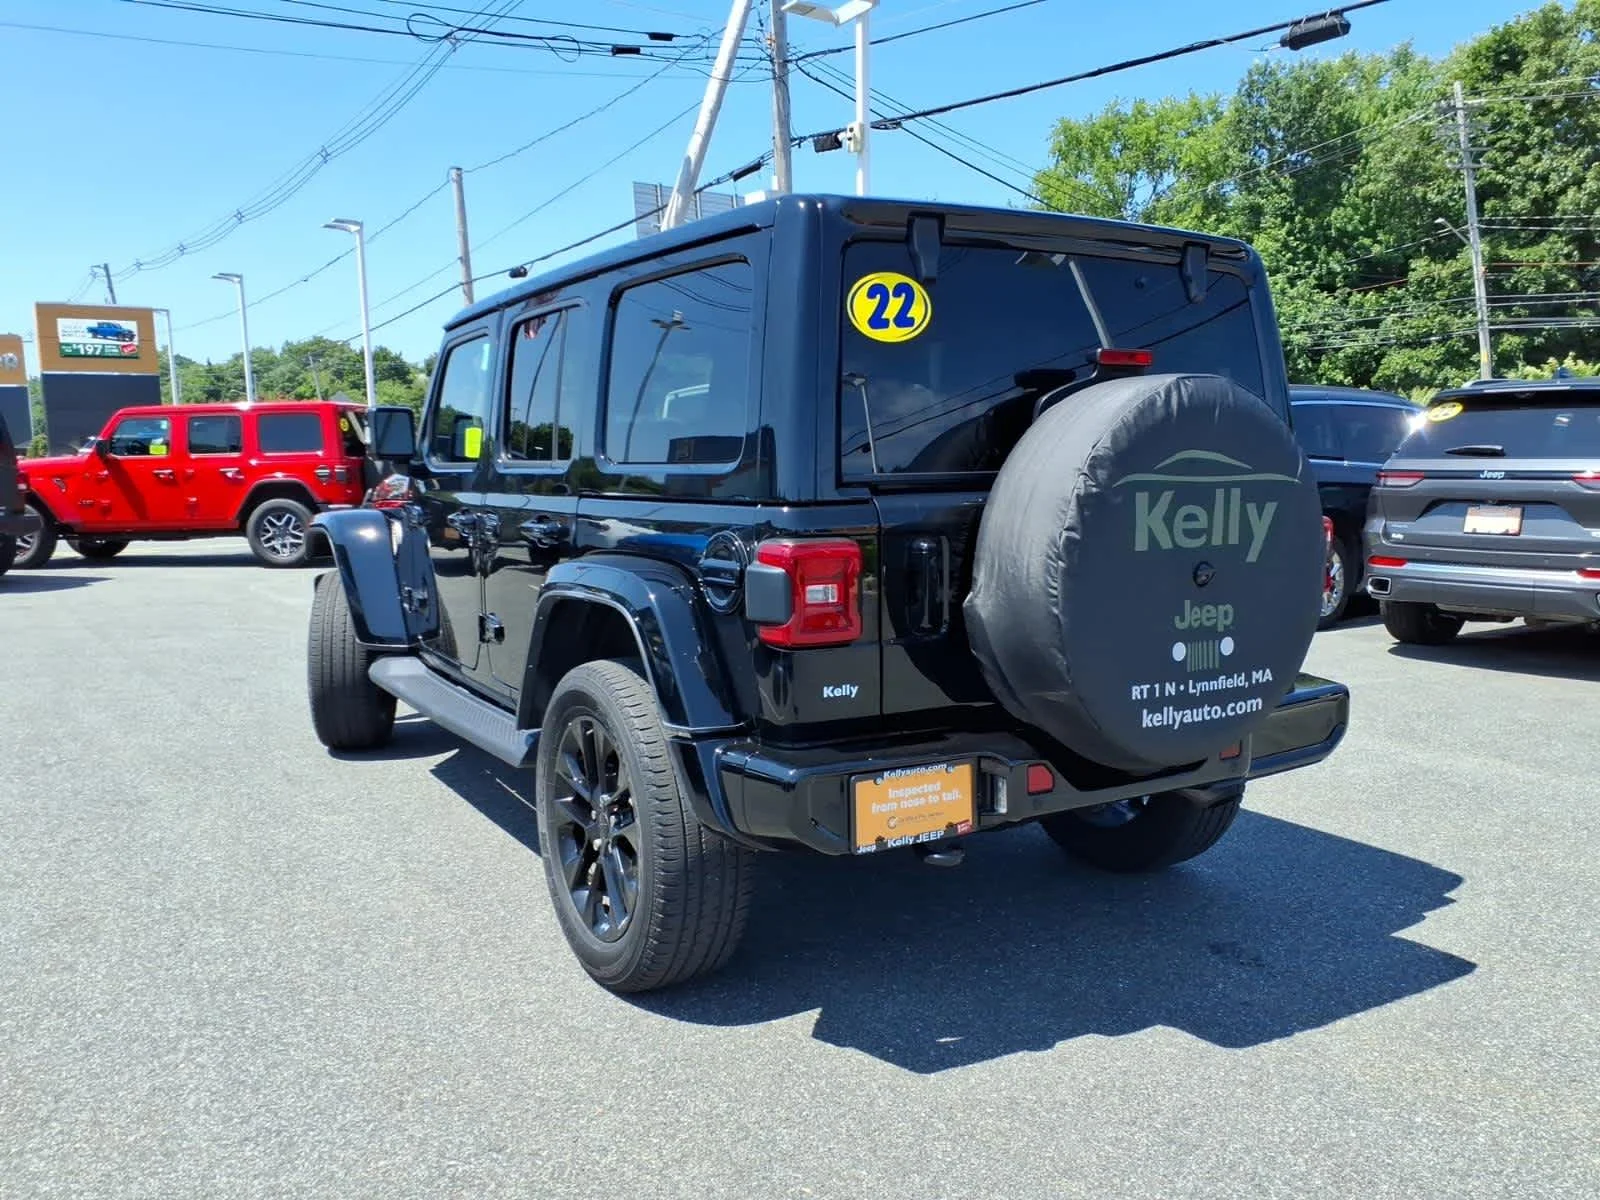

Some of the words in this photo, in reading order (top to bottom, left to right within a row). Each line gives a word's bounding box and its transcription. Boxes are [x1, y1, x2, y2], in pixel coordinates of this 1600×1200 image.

[867, 283, 915, 329] 22
[1480, 470, 1505, 480] Jeep
[1135, 488, 1278, 562] Kelly
[1174, 600, 1234, 632] Jeep
[823, 683, 859, 698] Kelly
[1131, 684, 1150, 700] RT
[1154, 682, 1160, 697] 1
[1165, 681, 1176, 697] N
[1188, 672, 1249, 696] Lynnfield,
[1252, 668, 1273, 685] MA
[1142, 697, 1263, 730] kellyauto.com
[883, 763, 947, 780] Kellyauto.com
[888, 781, 941, 799] Inspected
[871, 801, 897, 814] from
[900, 796, 926, 809] nose
[928, 794, 940, 804] to
[887, 834, 915, 848] Kelly
[916, 830, 945, 843] JEEP
[857, 844, 877, 854] Jeep
